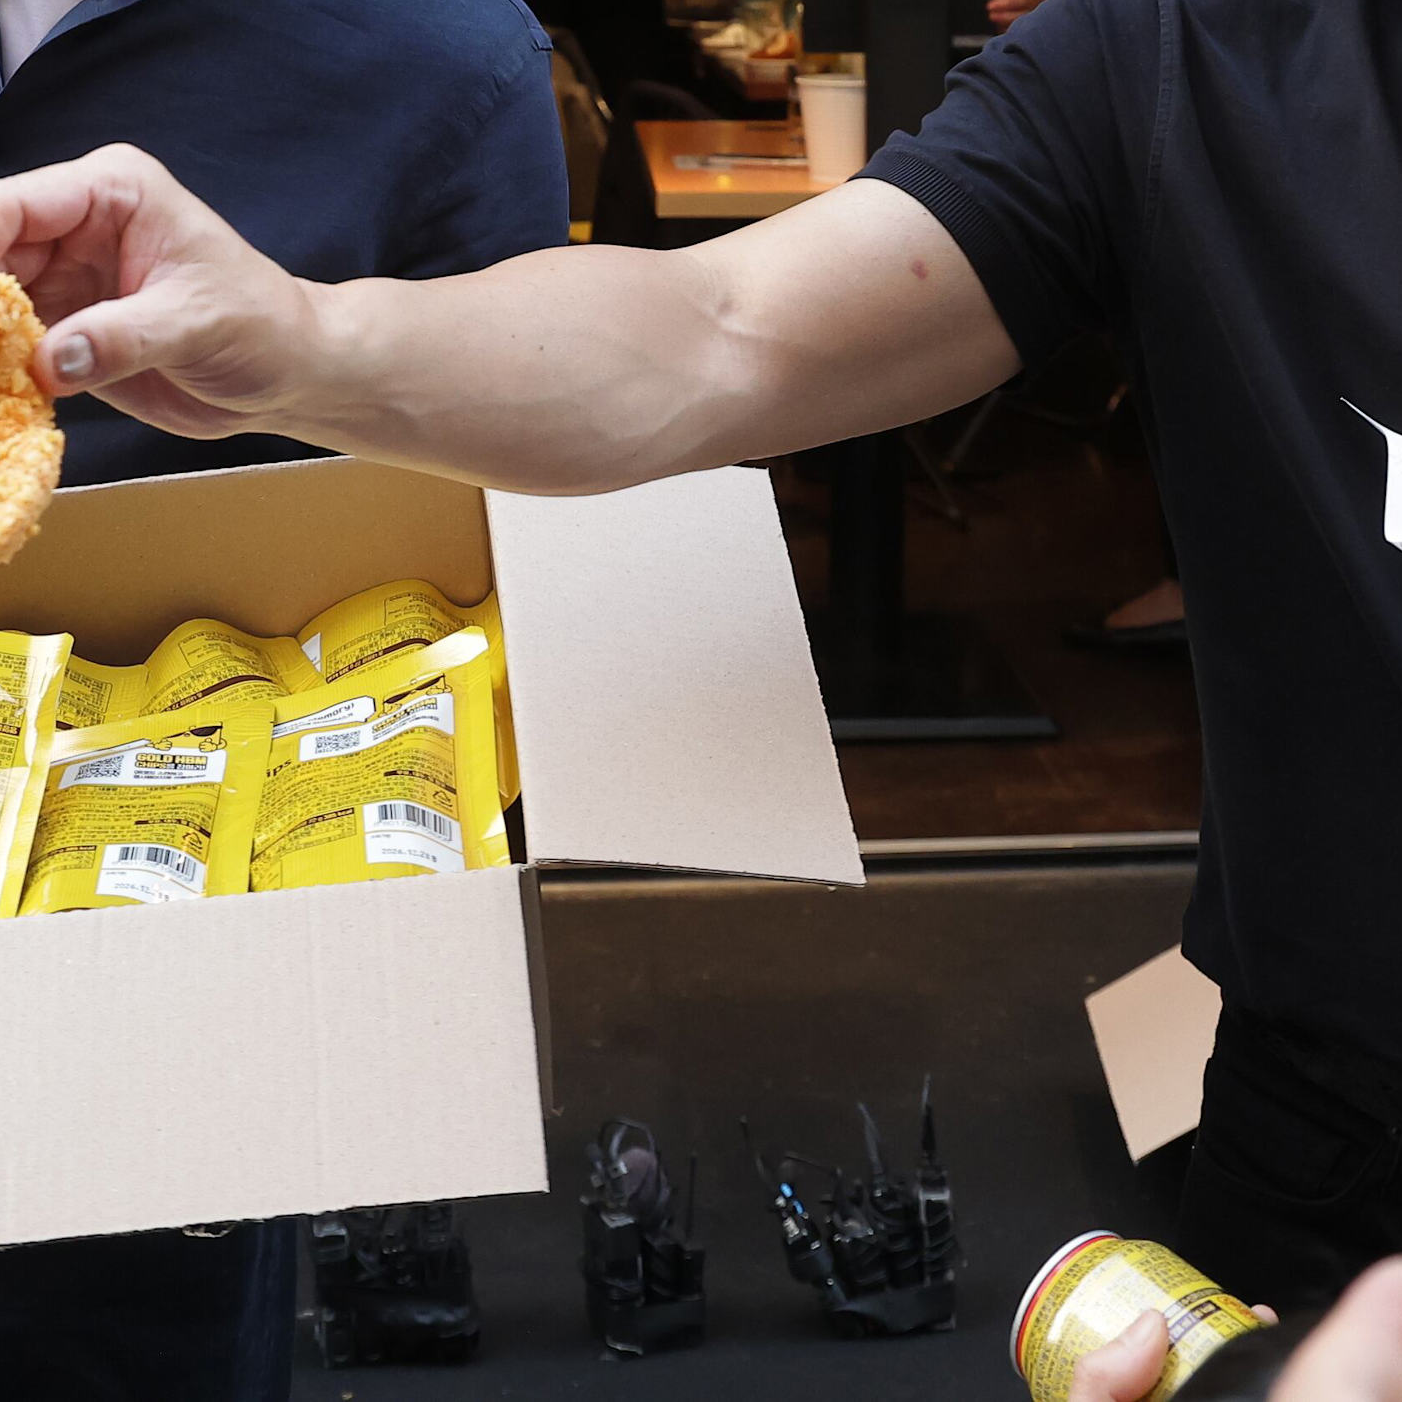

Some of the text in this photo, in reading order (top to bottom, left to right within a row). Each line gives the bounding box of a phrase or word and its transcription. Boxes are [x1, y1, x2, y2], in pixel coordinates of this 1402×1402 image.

[136, 753, 208, 766] GOLD HBM
[266, 759, 292, 778] ips
